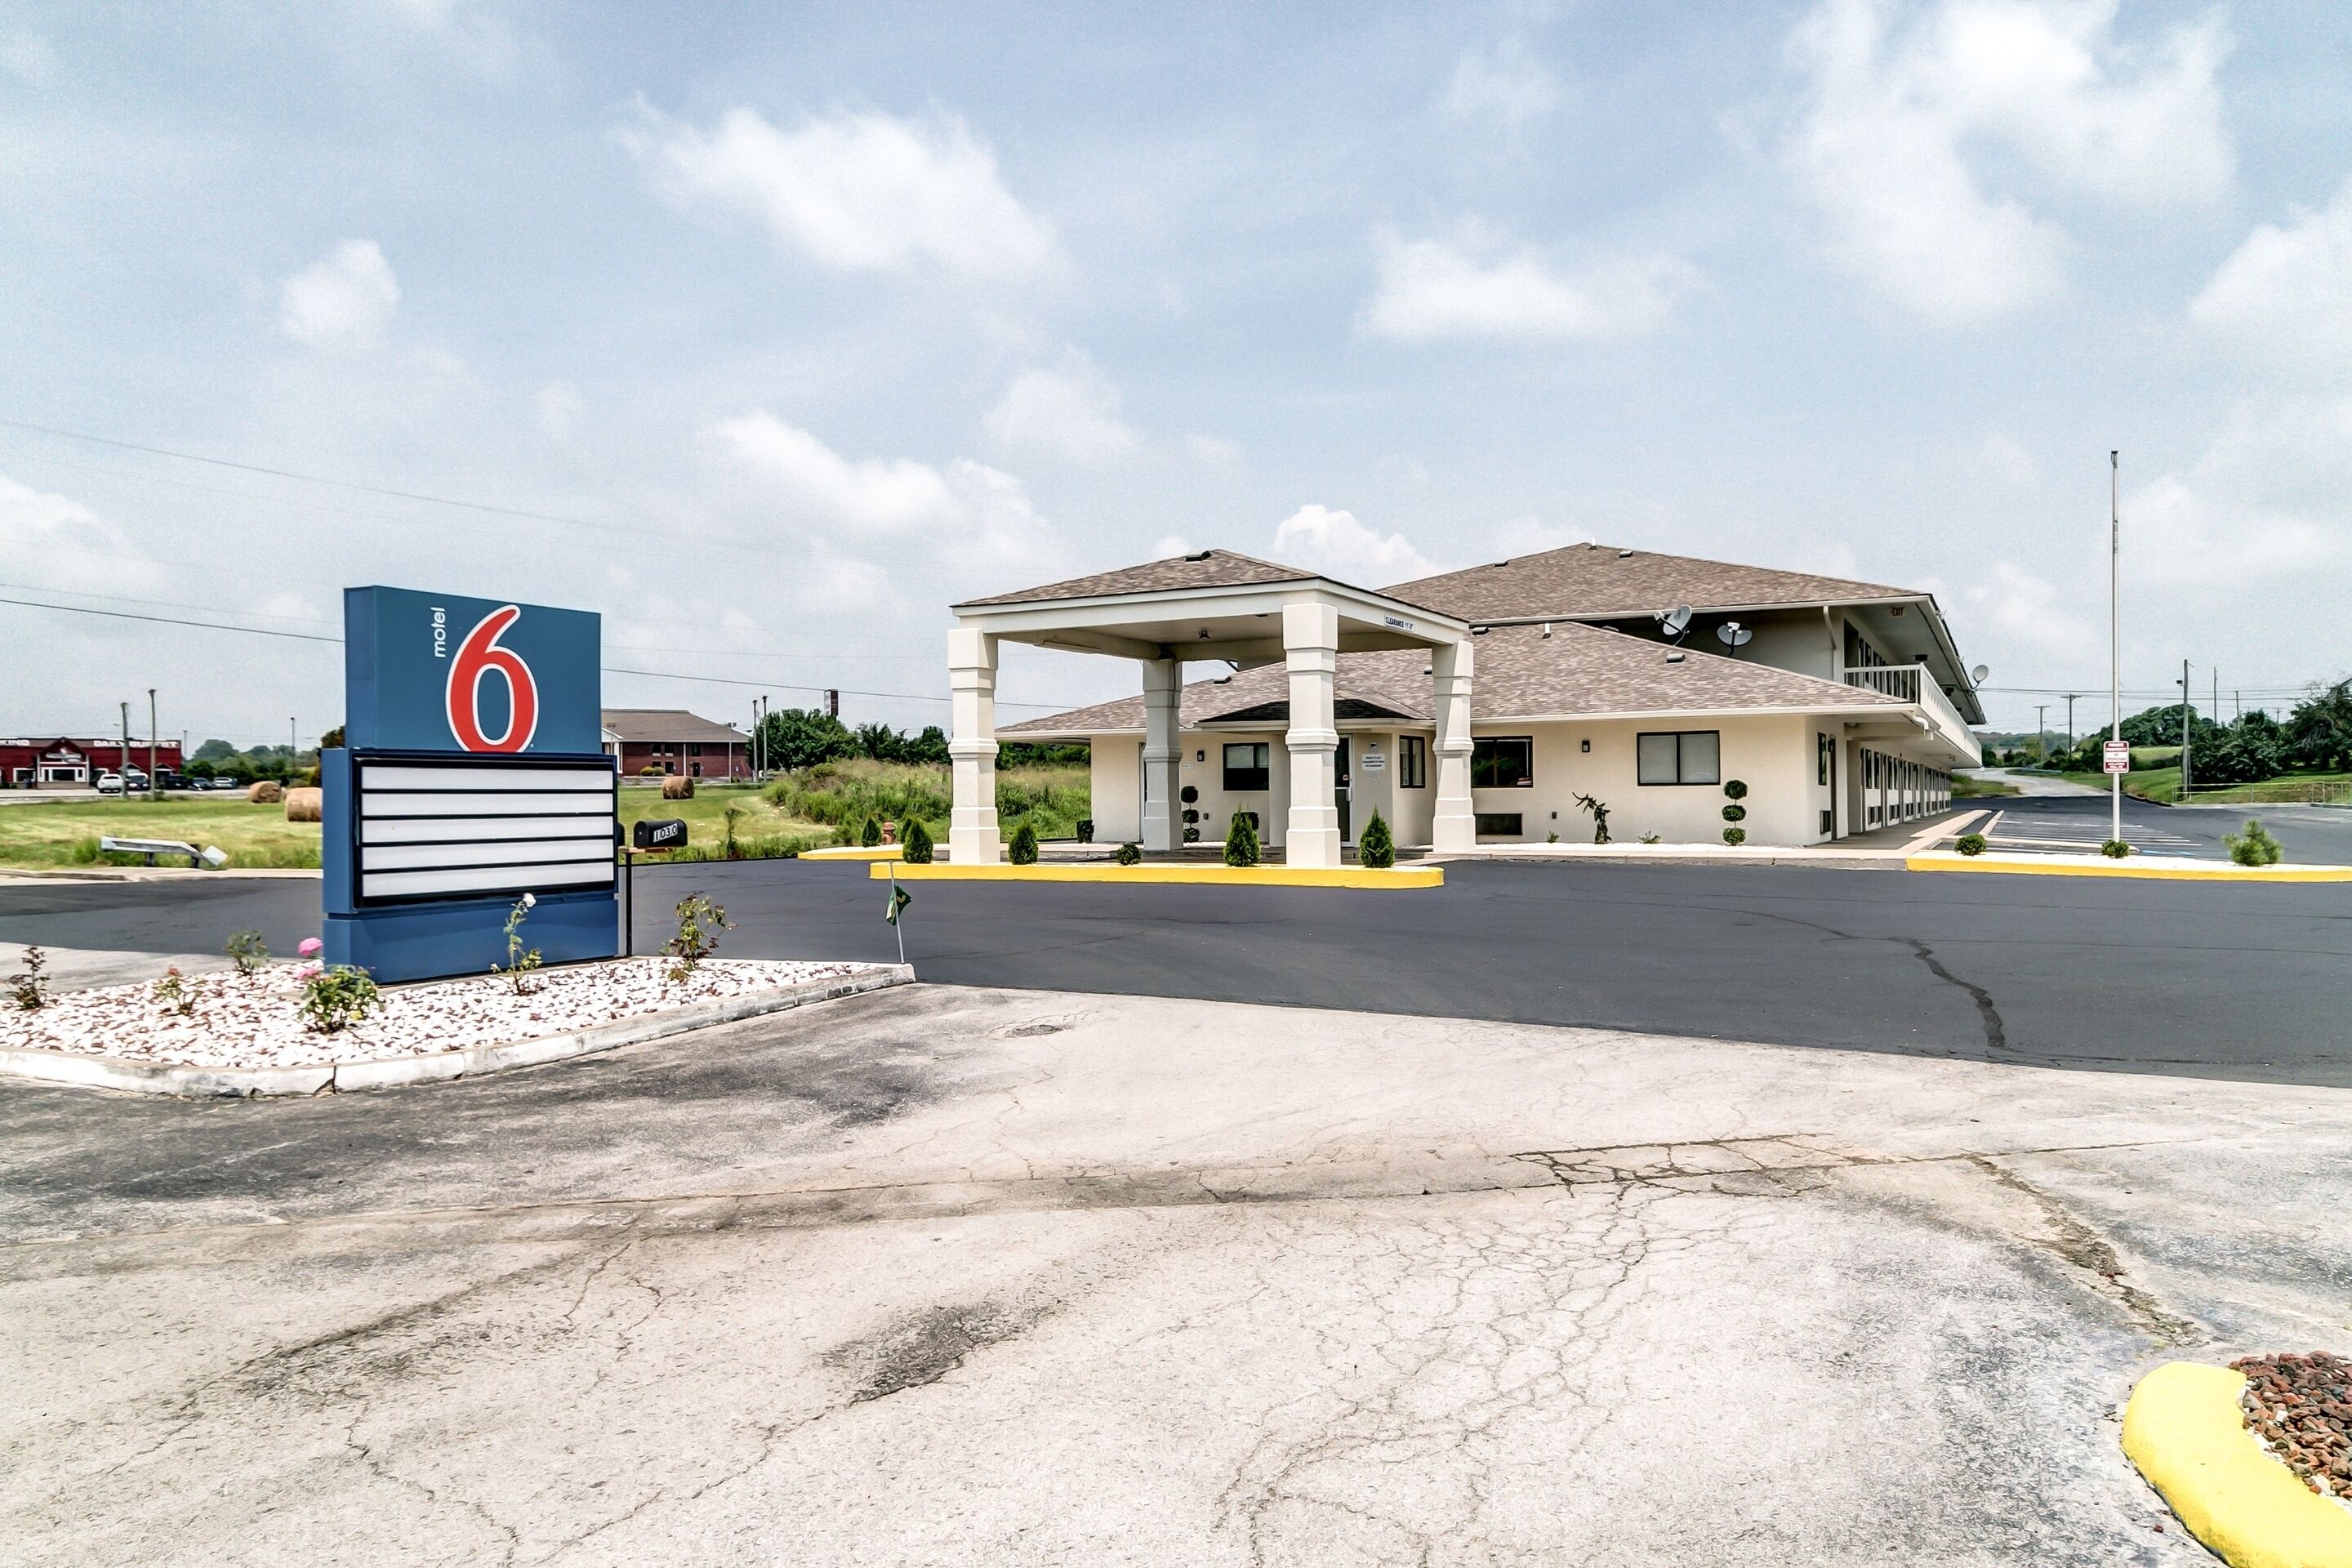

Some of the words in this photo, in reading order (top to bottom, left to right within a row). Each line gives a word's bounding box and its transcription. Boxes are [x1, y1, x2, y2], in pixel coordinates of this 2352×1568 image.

[1386, 617, 1404, 628] CLEARANCE
[430, 607, 447, 657] motel
[444, 604, 540, 753] 6
[656, 825, 677, 840] 1030
